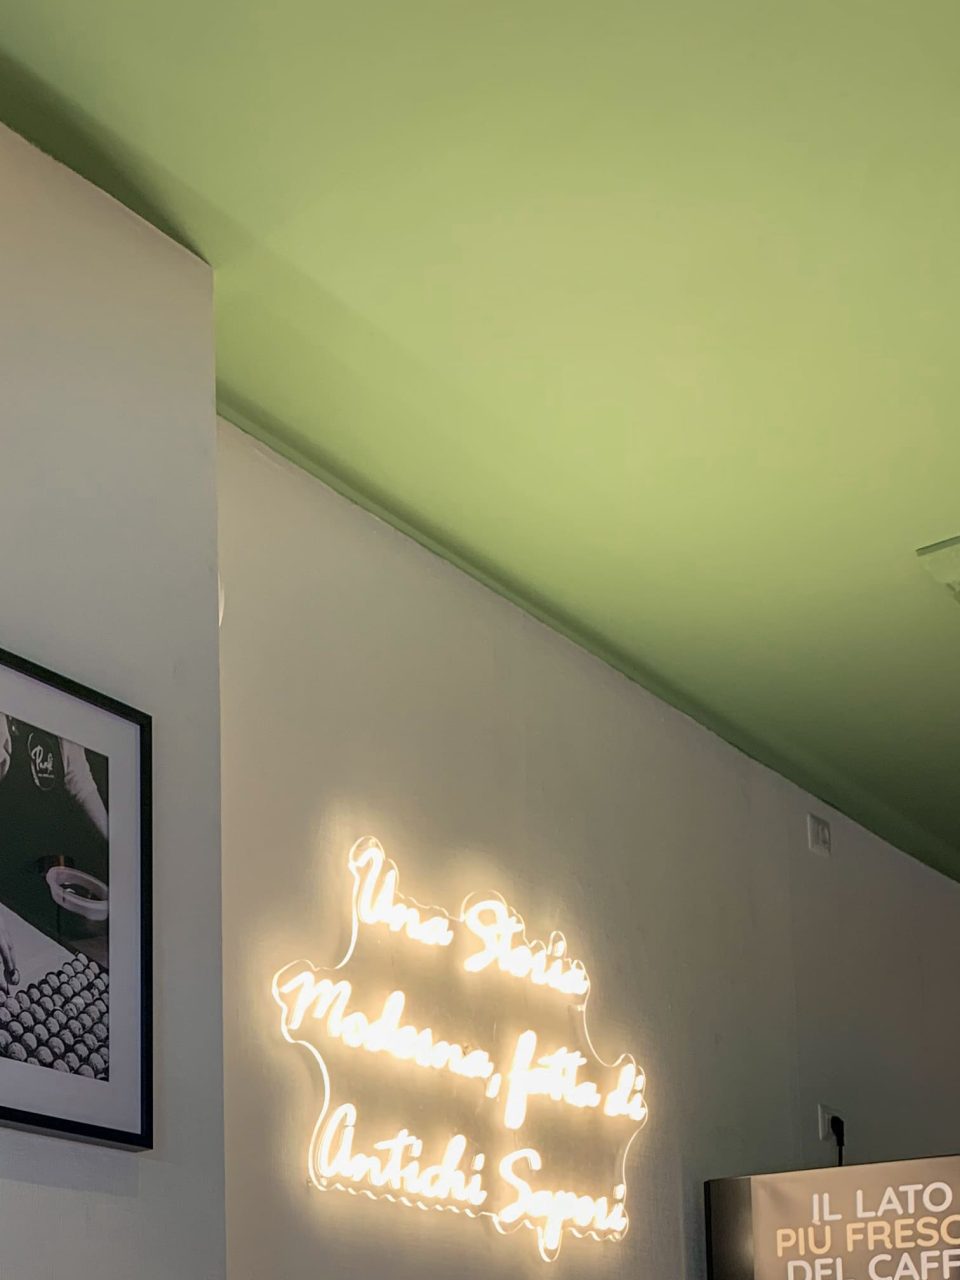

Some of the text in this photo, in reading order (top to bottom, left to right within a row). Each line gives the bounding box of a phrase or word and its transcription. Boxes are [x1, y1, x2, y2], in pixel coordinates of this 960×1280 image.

[349, 847, 589, 995] Una Storia
[504, 1030, 600, 1129] fatta
[604, 1063, 647, 1121] di
[318, 1103, 627, 1250] Antichi Sapori
[813, 1182, 953, 1221] IL LATO
[776, 1218, 832, 1257] PIÙ
